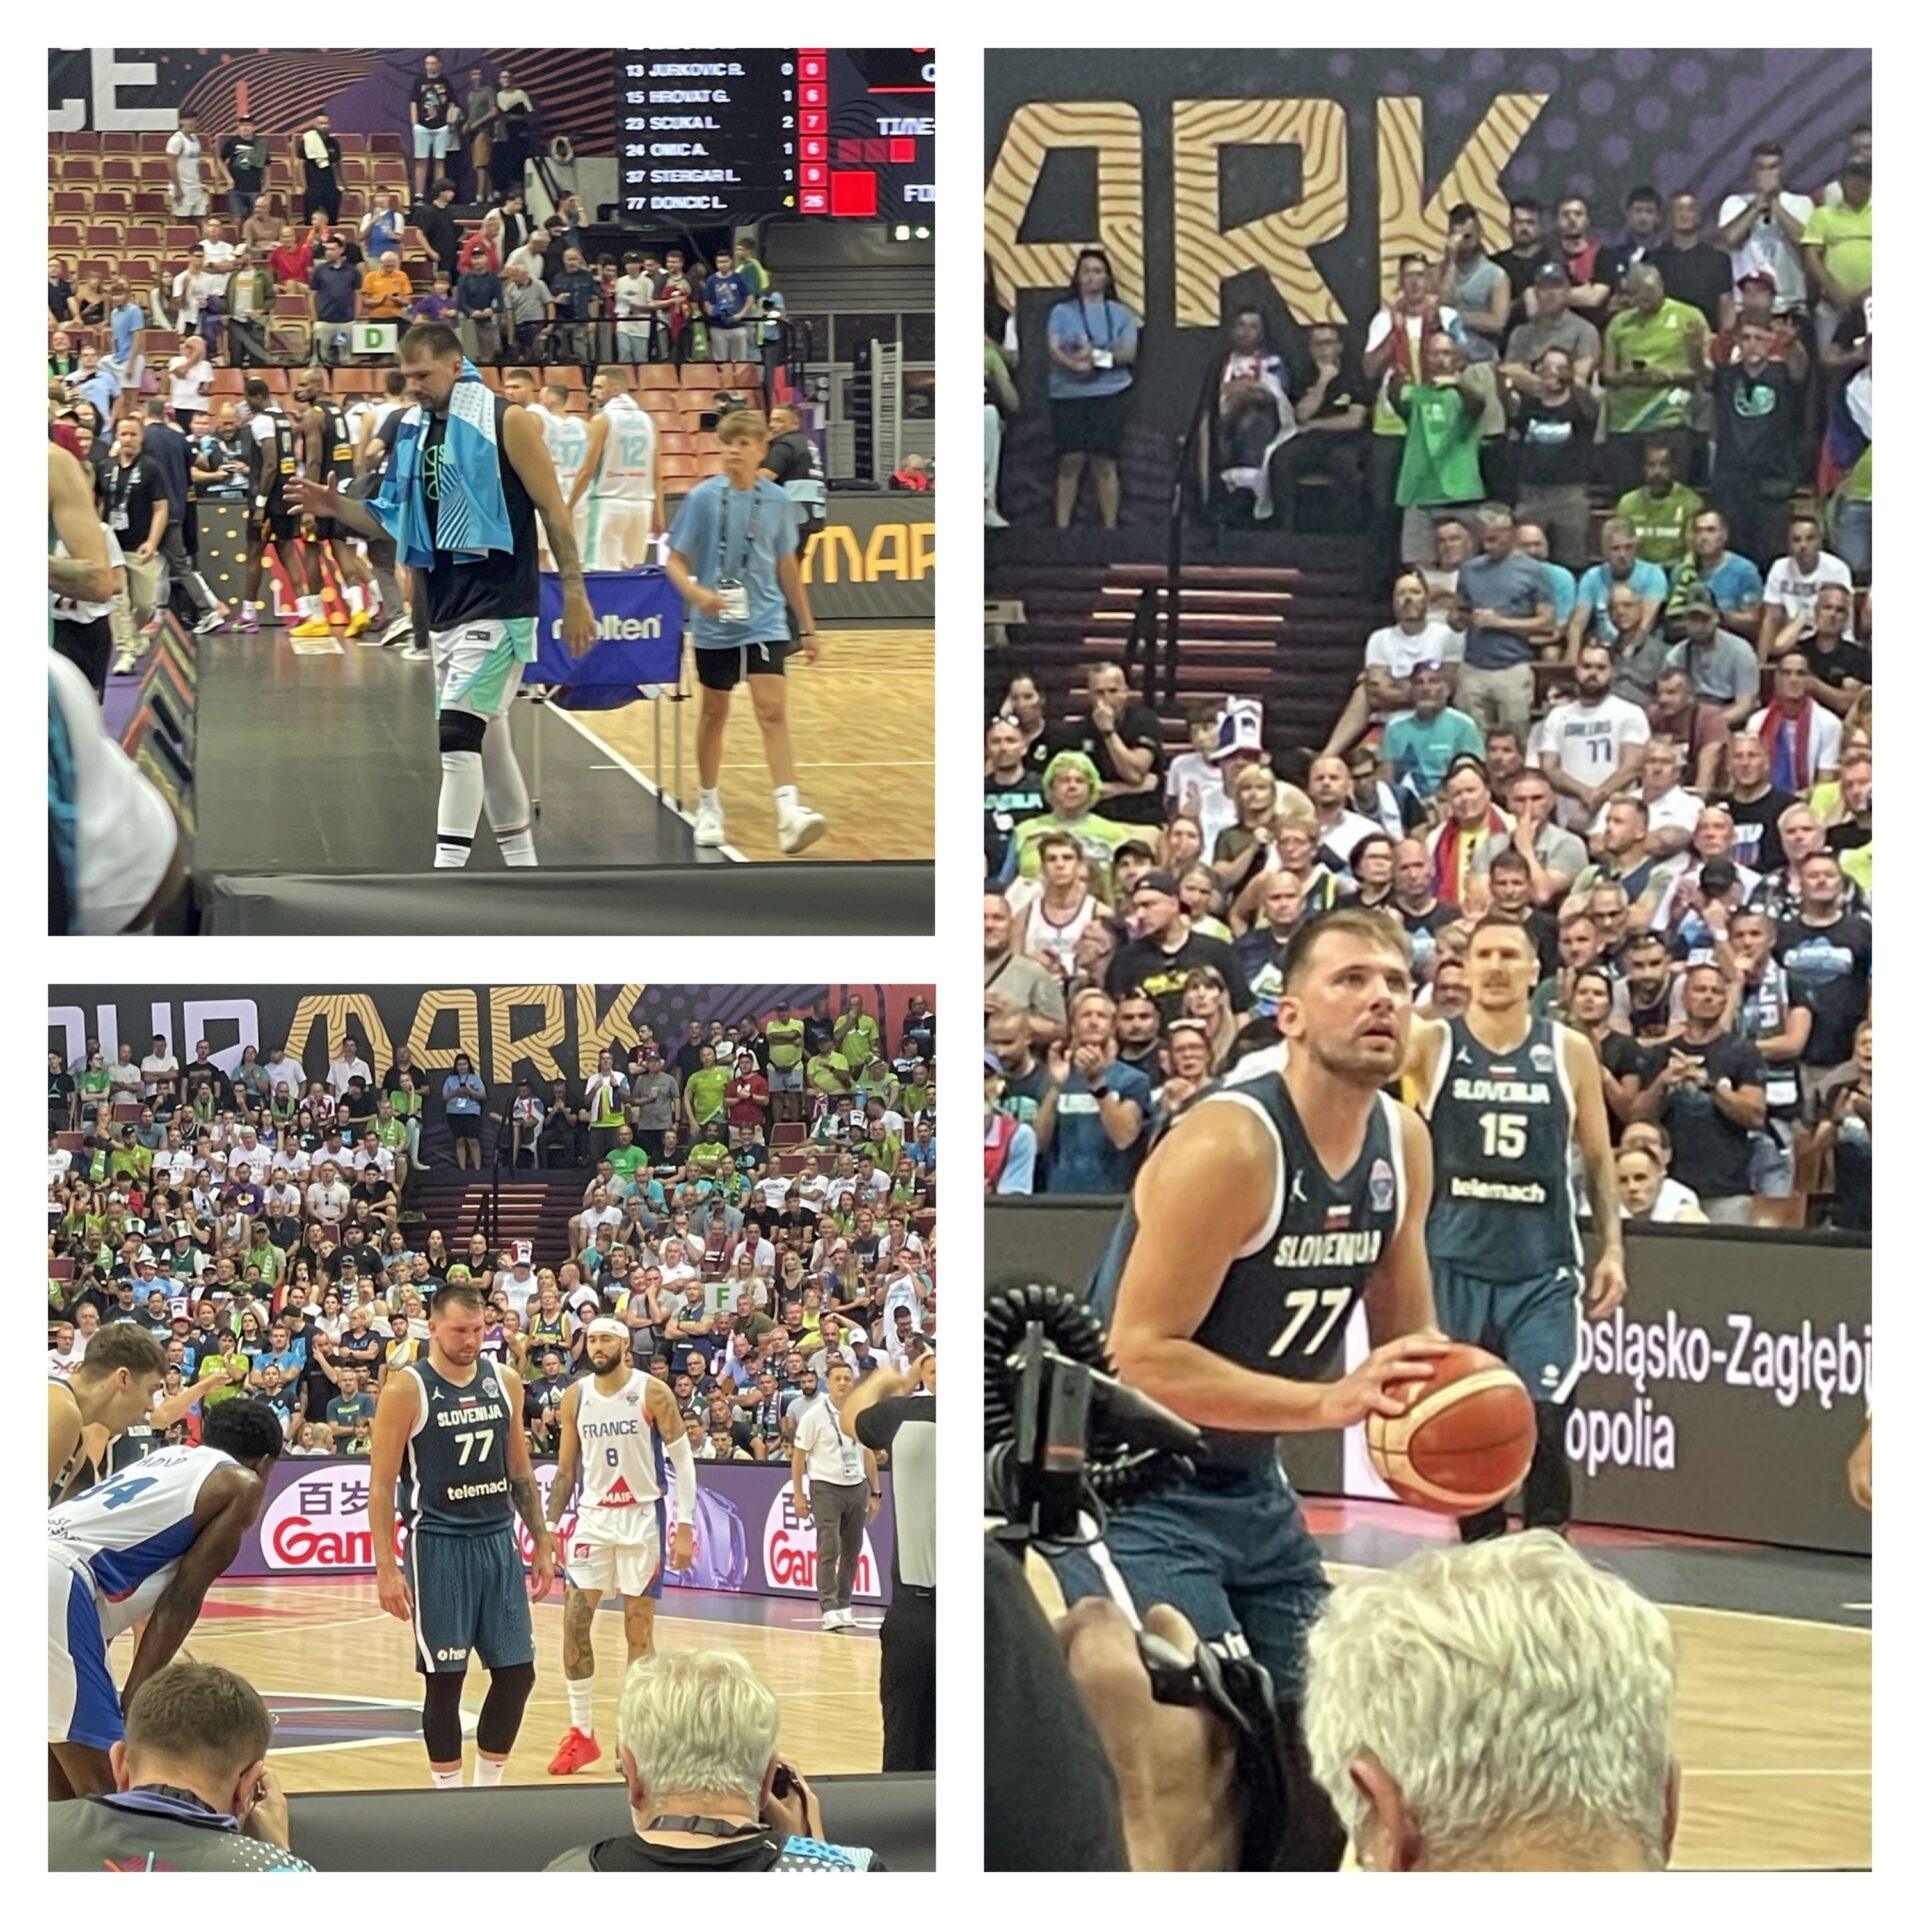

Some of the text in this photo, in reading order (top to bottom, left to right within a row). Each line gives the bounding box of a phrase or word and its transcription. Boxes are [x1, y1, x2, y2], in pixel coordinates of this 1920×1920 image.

[625, 64, 644, 77] 13
[625, 91, 645, 104] 15
[782, 89, 793, 102] 1
[625, 117, 645, 130] 23
[782, 115, 794, 129] 2
[806, 115, 819, 128] 7
[875, 117, 935, 136] TIME
[783, 142, 793, 155] 1
[626, 170, 646, 183] 37
[782, 168, 793, 181] 1
[626, 197, 647, 210] 77
[782, 195, 795, 208] 4
[366, 328, 382, 348] D
[620, 436, 647, 466] 12
[1587, 738, 1611, 763] 77
[284, 984, 647, 1088] MARK
[1452, 1077, 1551, 1105] SLOVENIJA
[1479, 1111, 1528, 1158] 15
[1451, 1176, 1546, 1203] telemach
[717, 1288, 730, 1308] F
[1268, 1287, 1352, 1357] 77
[437, 1404, 503, 1428] SLOVENIJA
[582, 1420, 639, 1440] FRANCE
[454, 1428, 494, 1466] 77
[606, 1447, 619, 1468] 8
[601, 1491, 634, 1505] MAIF
